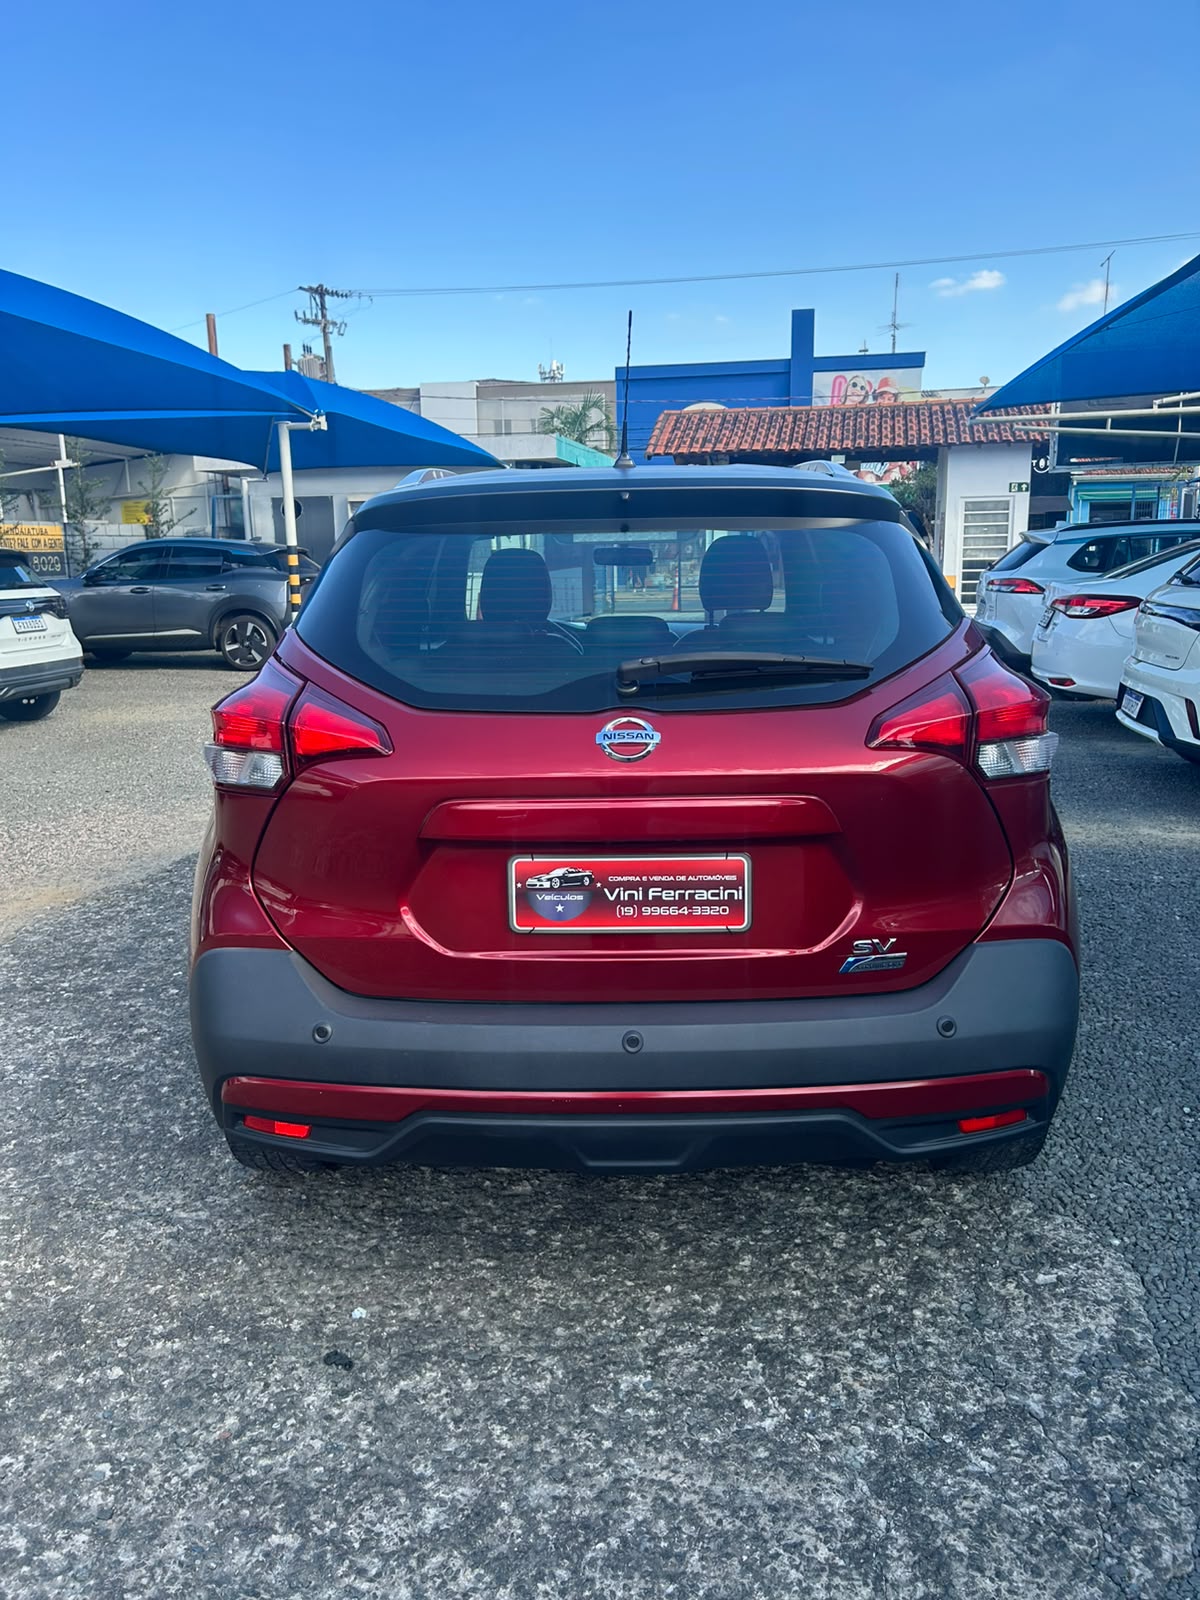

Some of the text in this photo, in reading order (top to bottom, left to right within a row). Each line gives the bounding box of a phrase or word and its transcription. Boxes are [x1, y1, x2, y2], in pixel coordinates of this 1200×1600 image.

[32, 556, 61, 572] 8029
[603, 732, 654, 740] NISSAN
[603, 886, 743, 901] Vini Ferracini
[616, 904, 730, 918] (19) 99664-3320
[853, 938, 897, 954] SV
